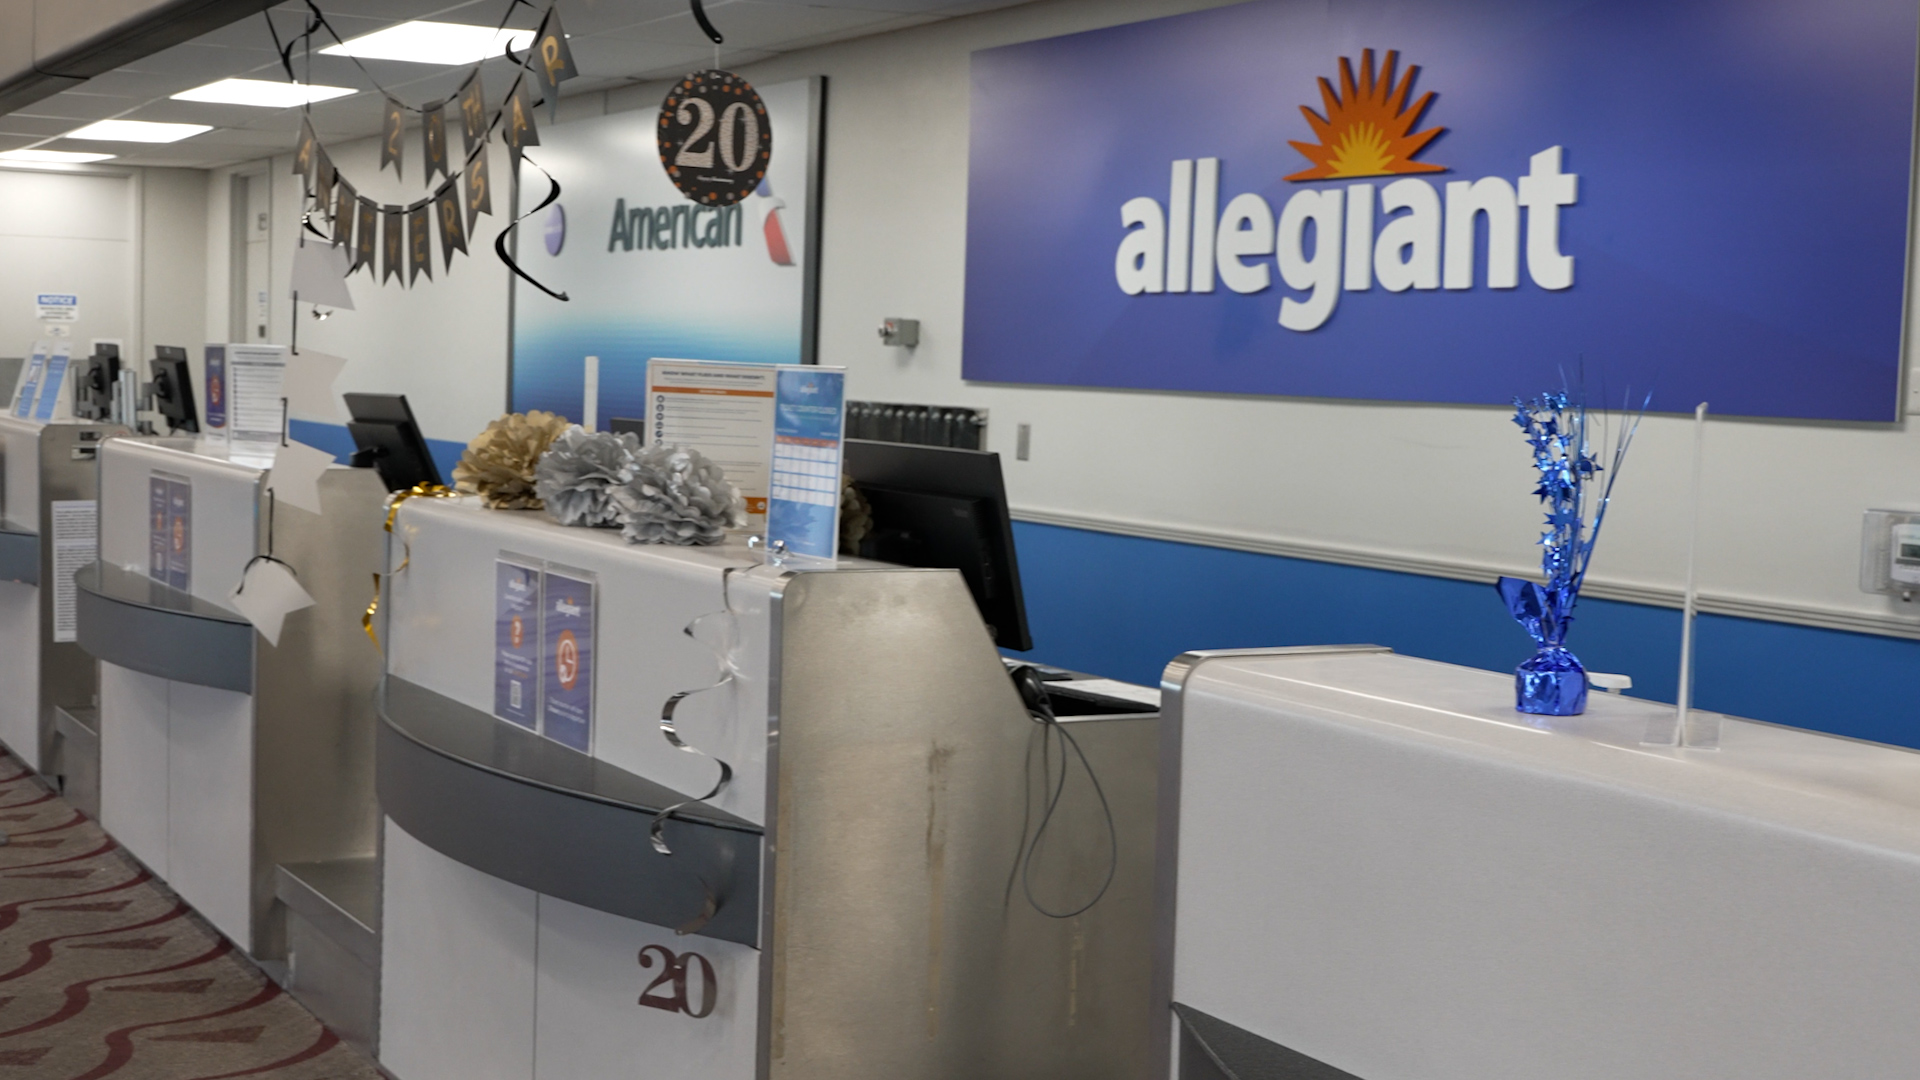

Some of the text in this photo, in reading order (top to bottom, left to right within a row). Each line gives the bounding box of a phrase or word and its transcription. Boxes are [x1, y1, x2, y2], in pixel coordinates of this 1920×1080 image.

[675, 97, 760, 172] 20
[608, 197, 743, 253] American
[1115, 145, 1578, 332] allegiant
[638, 944, 718, 1019] 20
